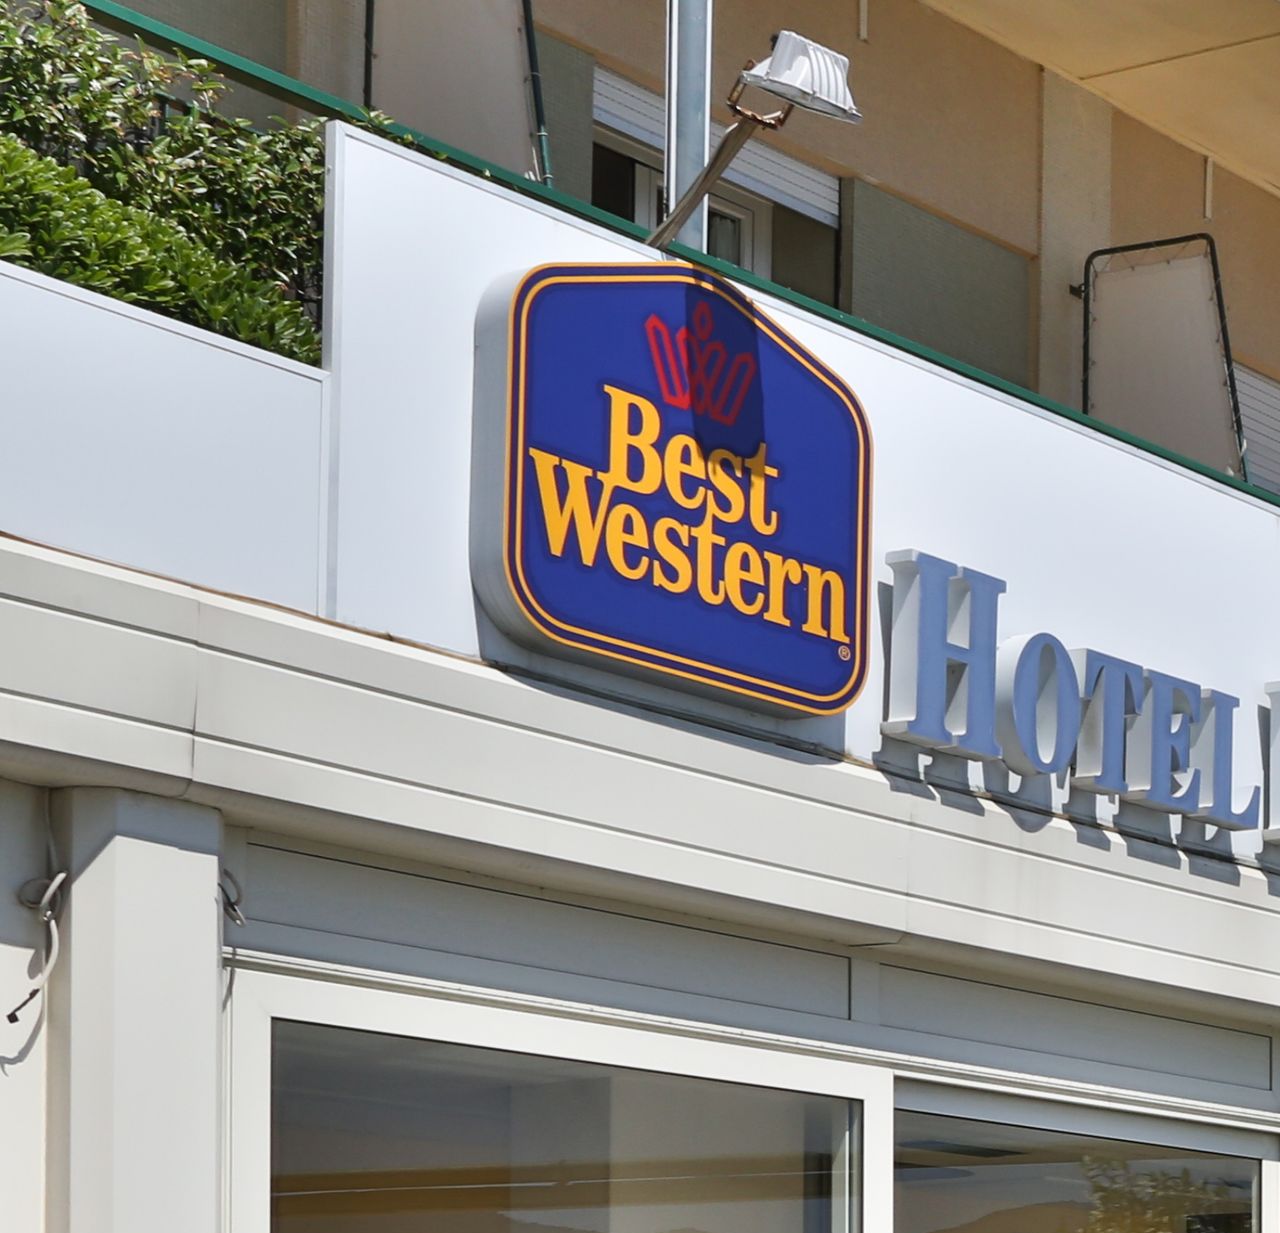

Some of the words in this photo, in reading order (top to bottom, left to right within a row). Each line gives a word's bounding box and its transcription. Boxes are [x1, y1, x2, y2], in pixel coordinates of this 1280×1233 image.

[528, 446, 850, 644] Western
[603, 384, 779, 536] Best
[881, 548, 1261, 831] HOTEL
